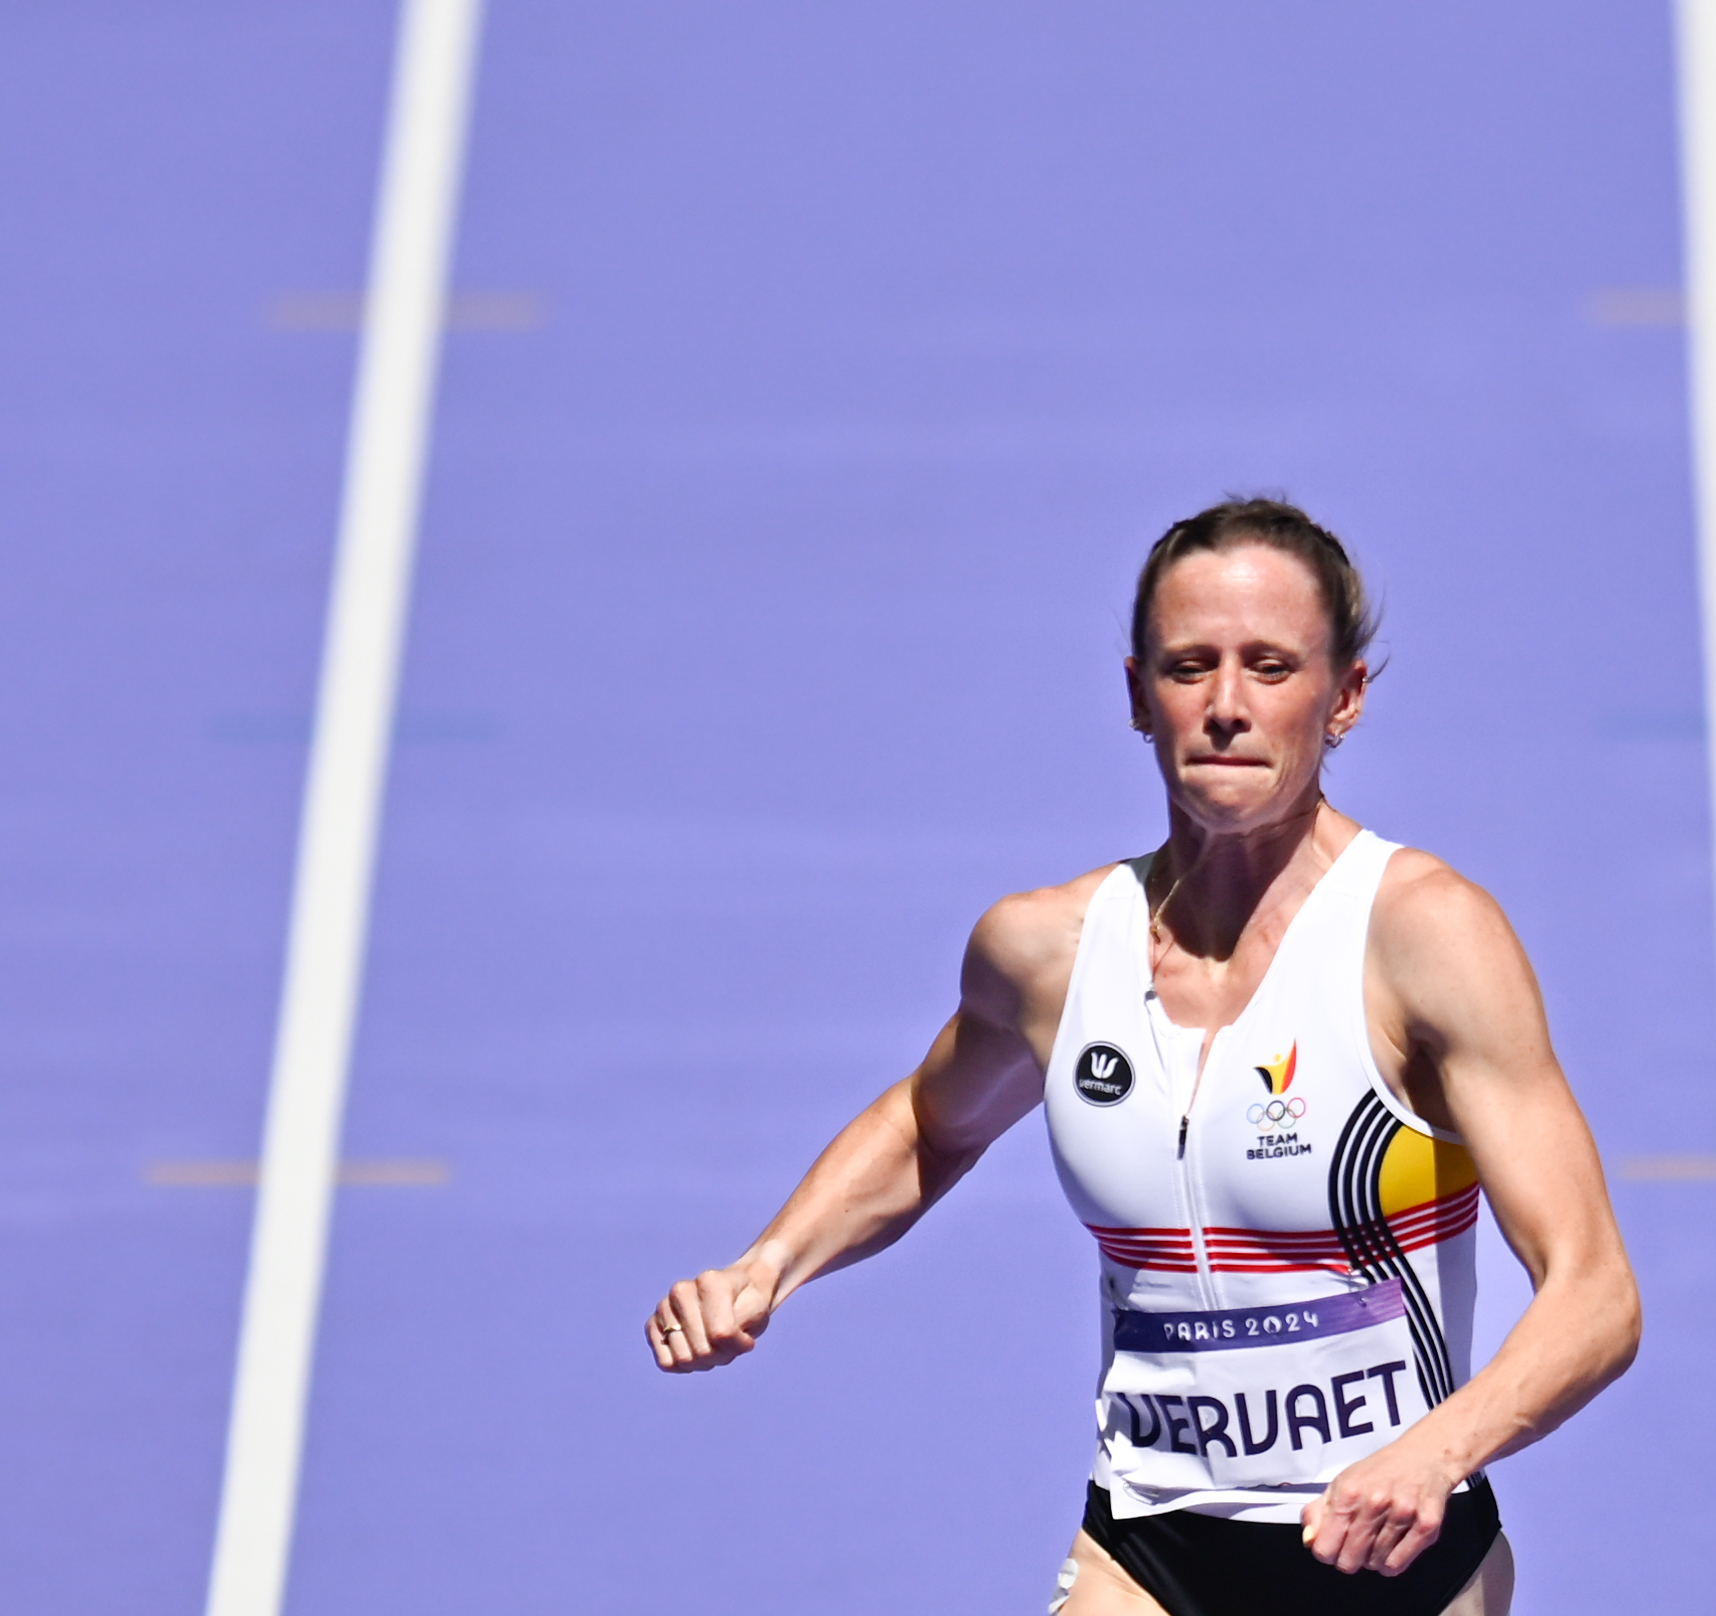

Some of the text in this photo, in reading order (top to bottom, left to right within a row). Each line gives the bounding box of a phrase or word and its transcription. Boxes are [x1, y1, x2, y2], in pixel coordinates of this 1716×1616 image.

[1078, 1079, 1122, 1096] vermarc
[1256, 1132, 1299, 1147] TEAM
[1246, 1143, 1312, 1161] BELGIUM
[1163, 1311, 1319, 1341] PARIS 2024
[1112, 1359, 1407, 1459] VERVAET
